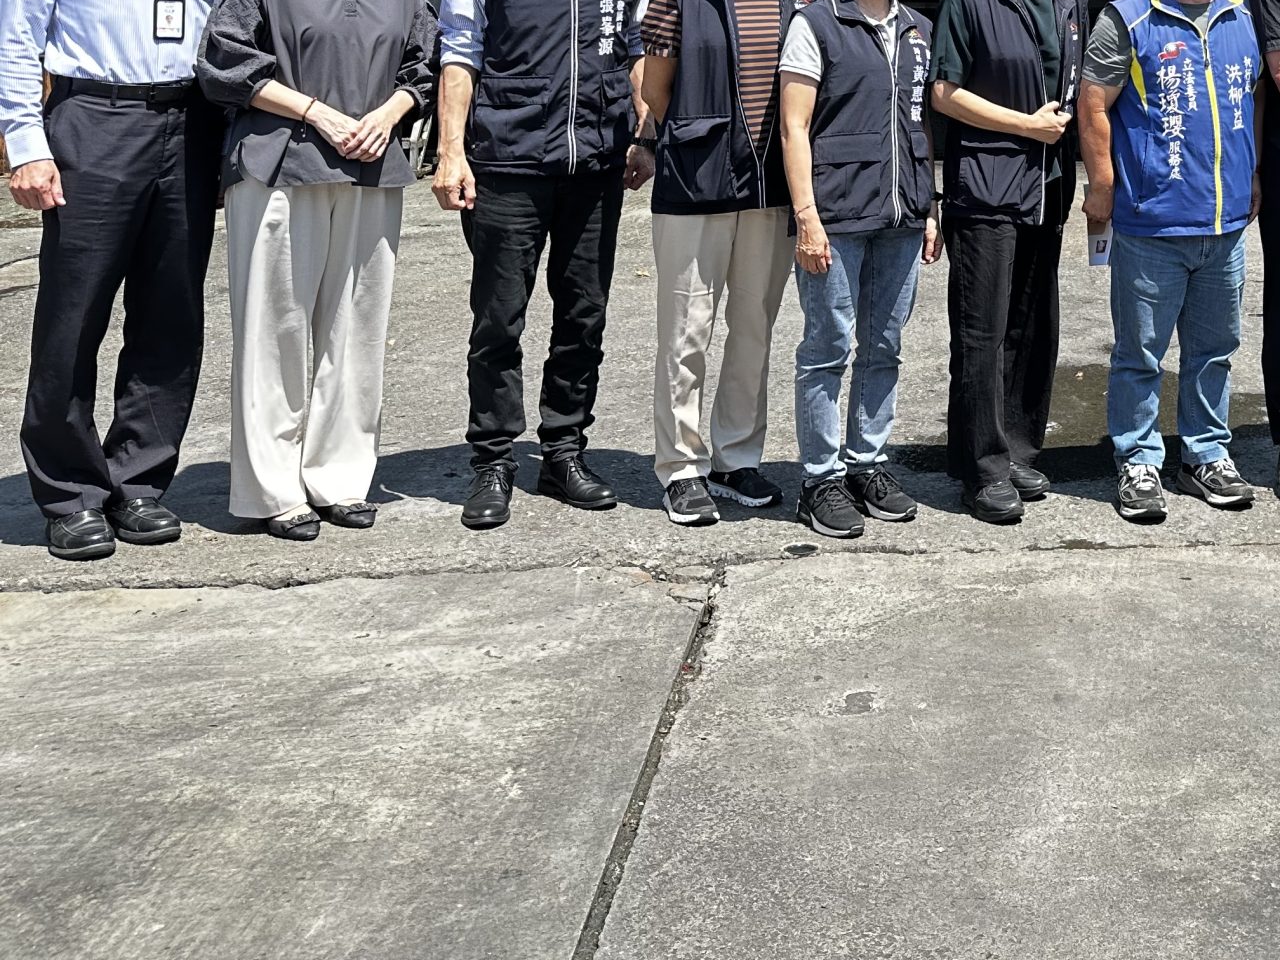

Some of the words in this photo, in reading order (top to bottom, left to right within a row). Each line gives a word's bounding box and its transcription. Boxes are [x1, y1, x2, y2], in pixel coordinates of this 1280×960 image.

[1182, 58, 1198, 112] 立法委員
[1225, 63, 1244, 130] 洪柳益
